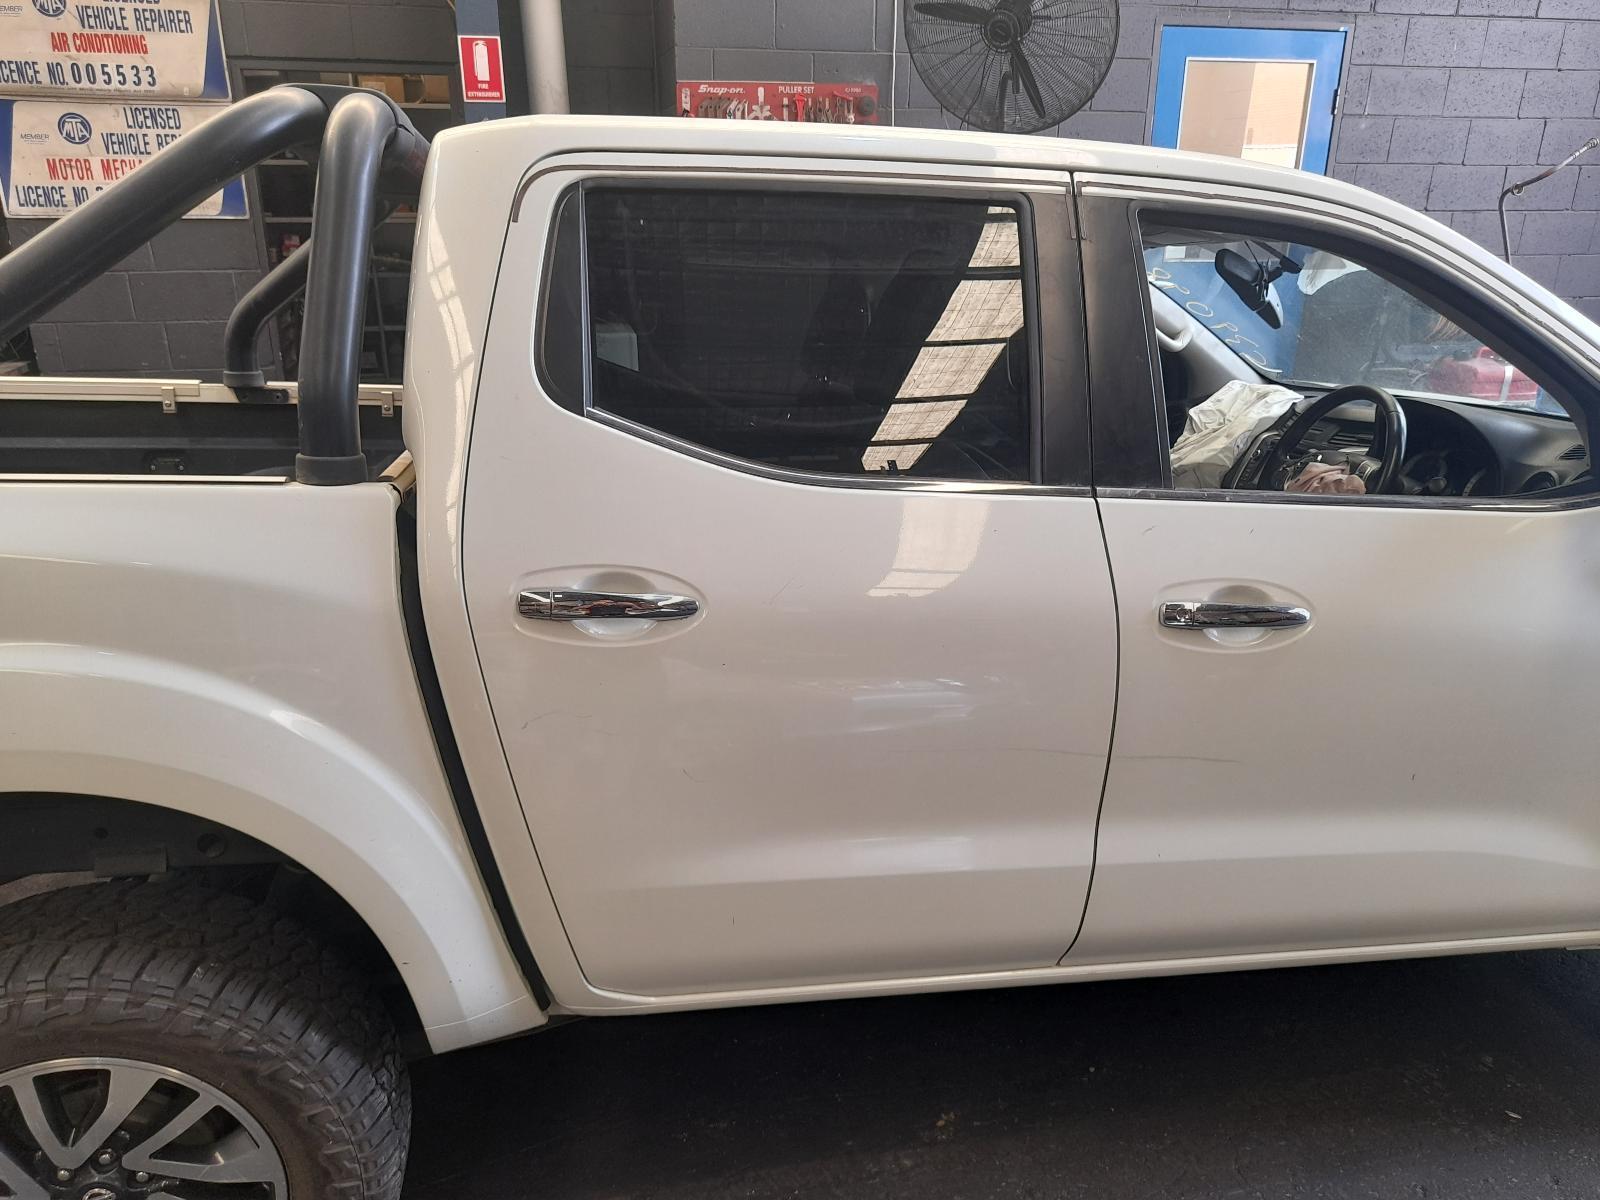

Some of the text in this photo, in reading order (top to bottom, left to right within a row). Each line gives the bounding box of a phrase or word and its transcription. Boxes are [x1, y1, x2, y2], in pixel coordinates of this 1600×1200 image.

[76, 5, 193, 34] VEHICLE REPAIRER
[50, 32, 149, 55] AIR CONDITIONING
[0, 60, 42, 85] CENCE
[46, 62, 69, 86] NO.
[778, 86, 815, 94] PULLER SET
[123, 107, 181, 130] LICENSED
[61, 117, 91, 144] MTA
[101, 132, 152, 156] VEHICLE
[46, 158, 94, 181] MOTOR
[15, 185, 68, 208] LICENCE
